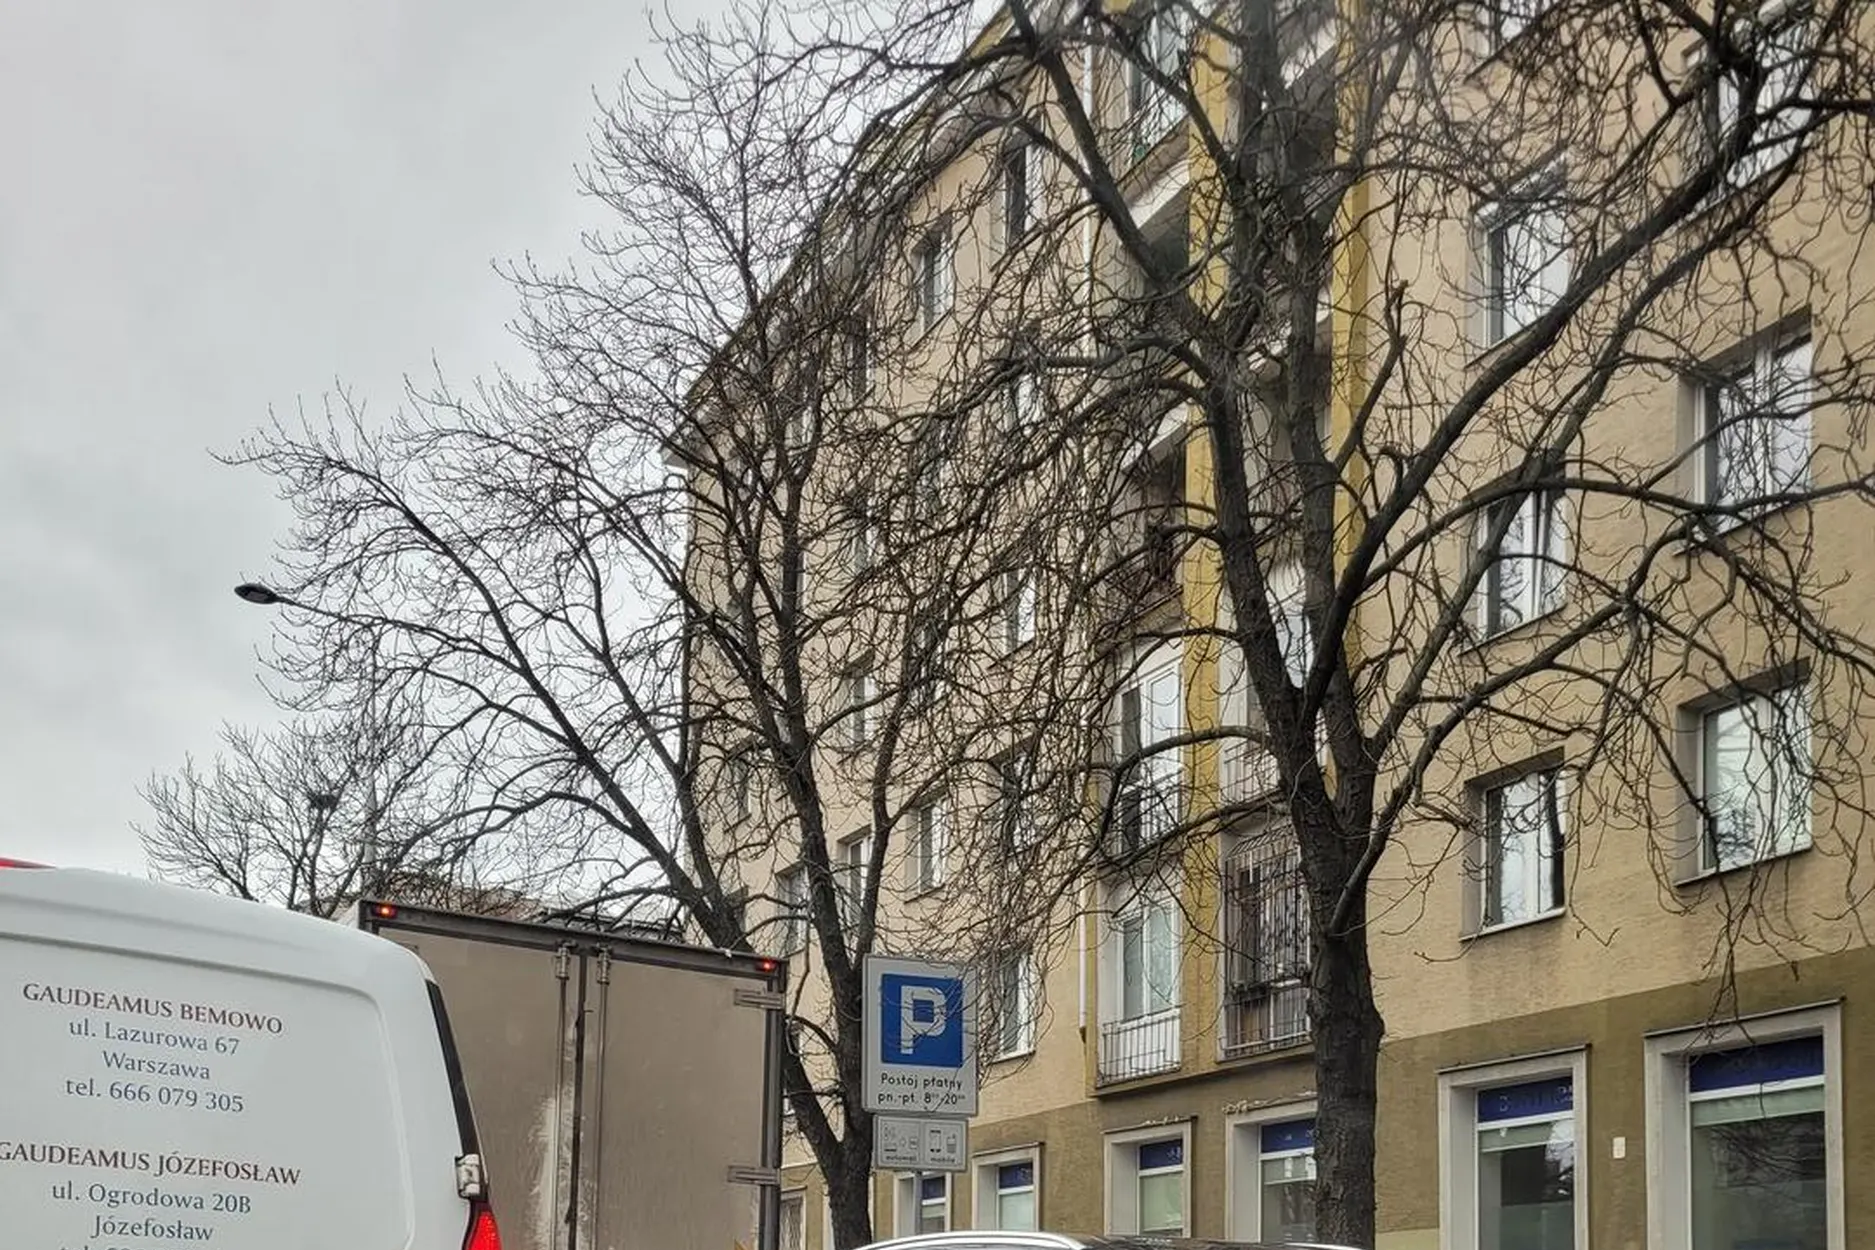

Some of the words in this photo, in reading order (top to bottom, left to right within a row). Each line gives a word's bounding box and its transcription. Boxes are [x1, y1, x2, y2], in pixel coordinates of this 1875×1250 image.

[23, 982, 173, 1018] GAUDEAMUS
[180, 1002, 283, 1034] BEMOWO
[900, 984, 946, 1055] P
[69, 1018, 96, 1038] ul.
[104, 1021, 209, 1052] Lazurowa
[214, 1037, 240, 1056] 67
[102, 1050, 211, 1080] Warszawa
[880, 1072, 918, 1089] Postój
[922, 1076, 962, 1091] płatny
[66, 1078, 102, 1098] tel.
[109, 1080, 151, 1102] 666
[158, 1086, 198, 1108] 079
[205, 1090, 244, 1113] 305
[0, 1141, 150, 1171] GAUDEAMUS
[154, 1150, 301, 1185] JÓZEFOSŁAW
[52, 1180, 80, 1201] ul.
[88, 1183, 205, 1210] Ogrodowa
[211, 1193, 252, 1214] 20B
[90, 1214, 214, 1241] Józefosław
